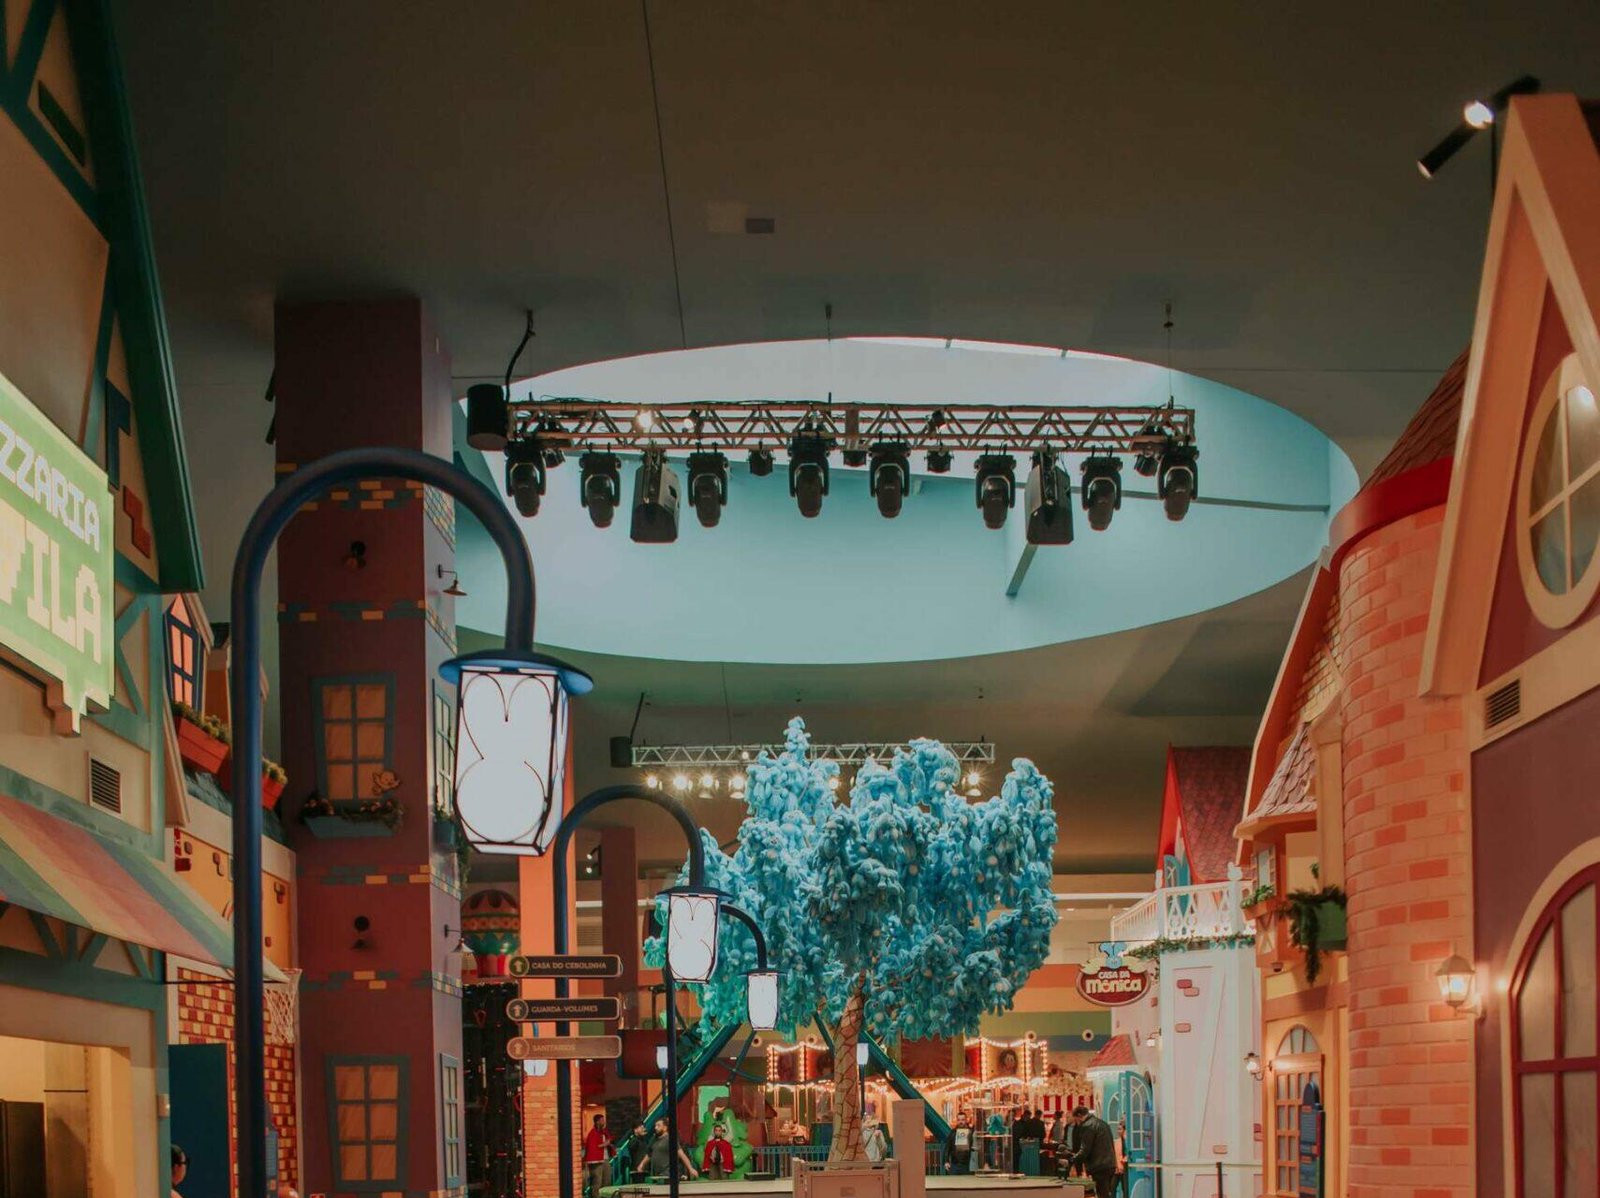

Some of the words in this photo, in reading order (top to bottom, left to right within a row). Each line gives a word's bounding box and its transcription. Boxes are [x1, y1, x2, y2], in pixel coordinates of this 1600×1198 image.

[531, 962, 551, 970] CASA
[553, 962, 564, 970] DO
[565, 961, 607, 970] CEBOLINHA
[1098, 971, 1118, 980] CASA
[1119, 970, 1131, 979] DA
